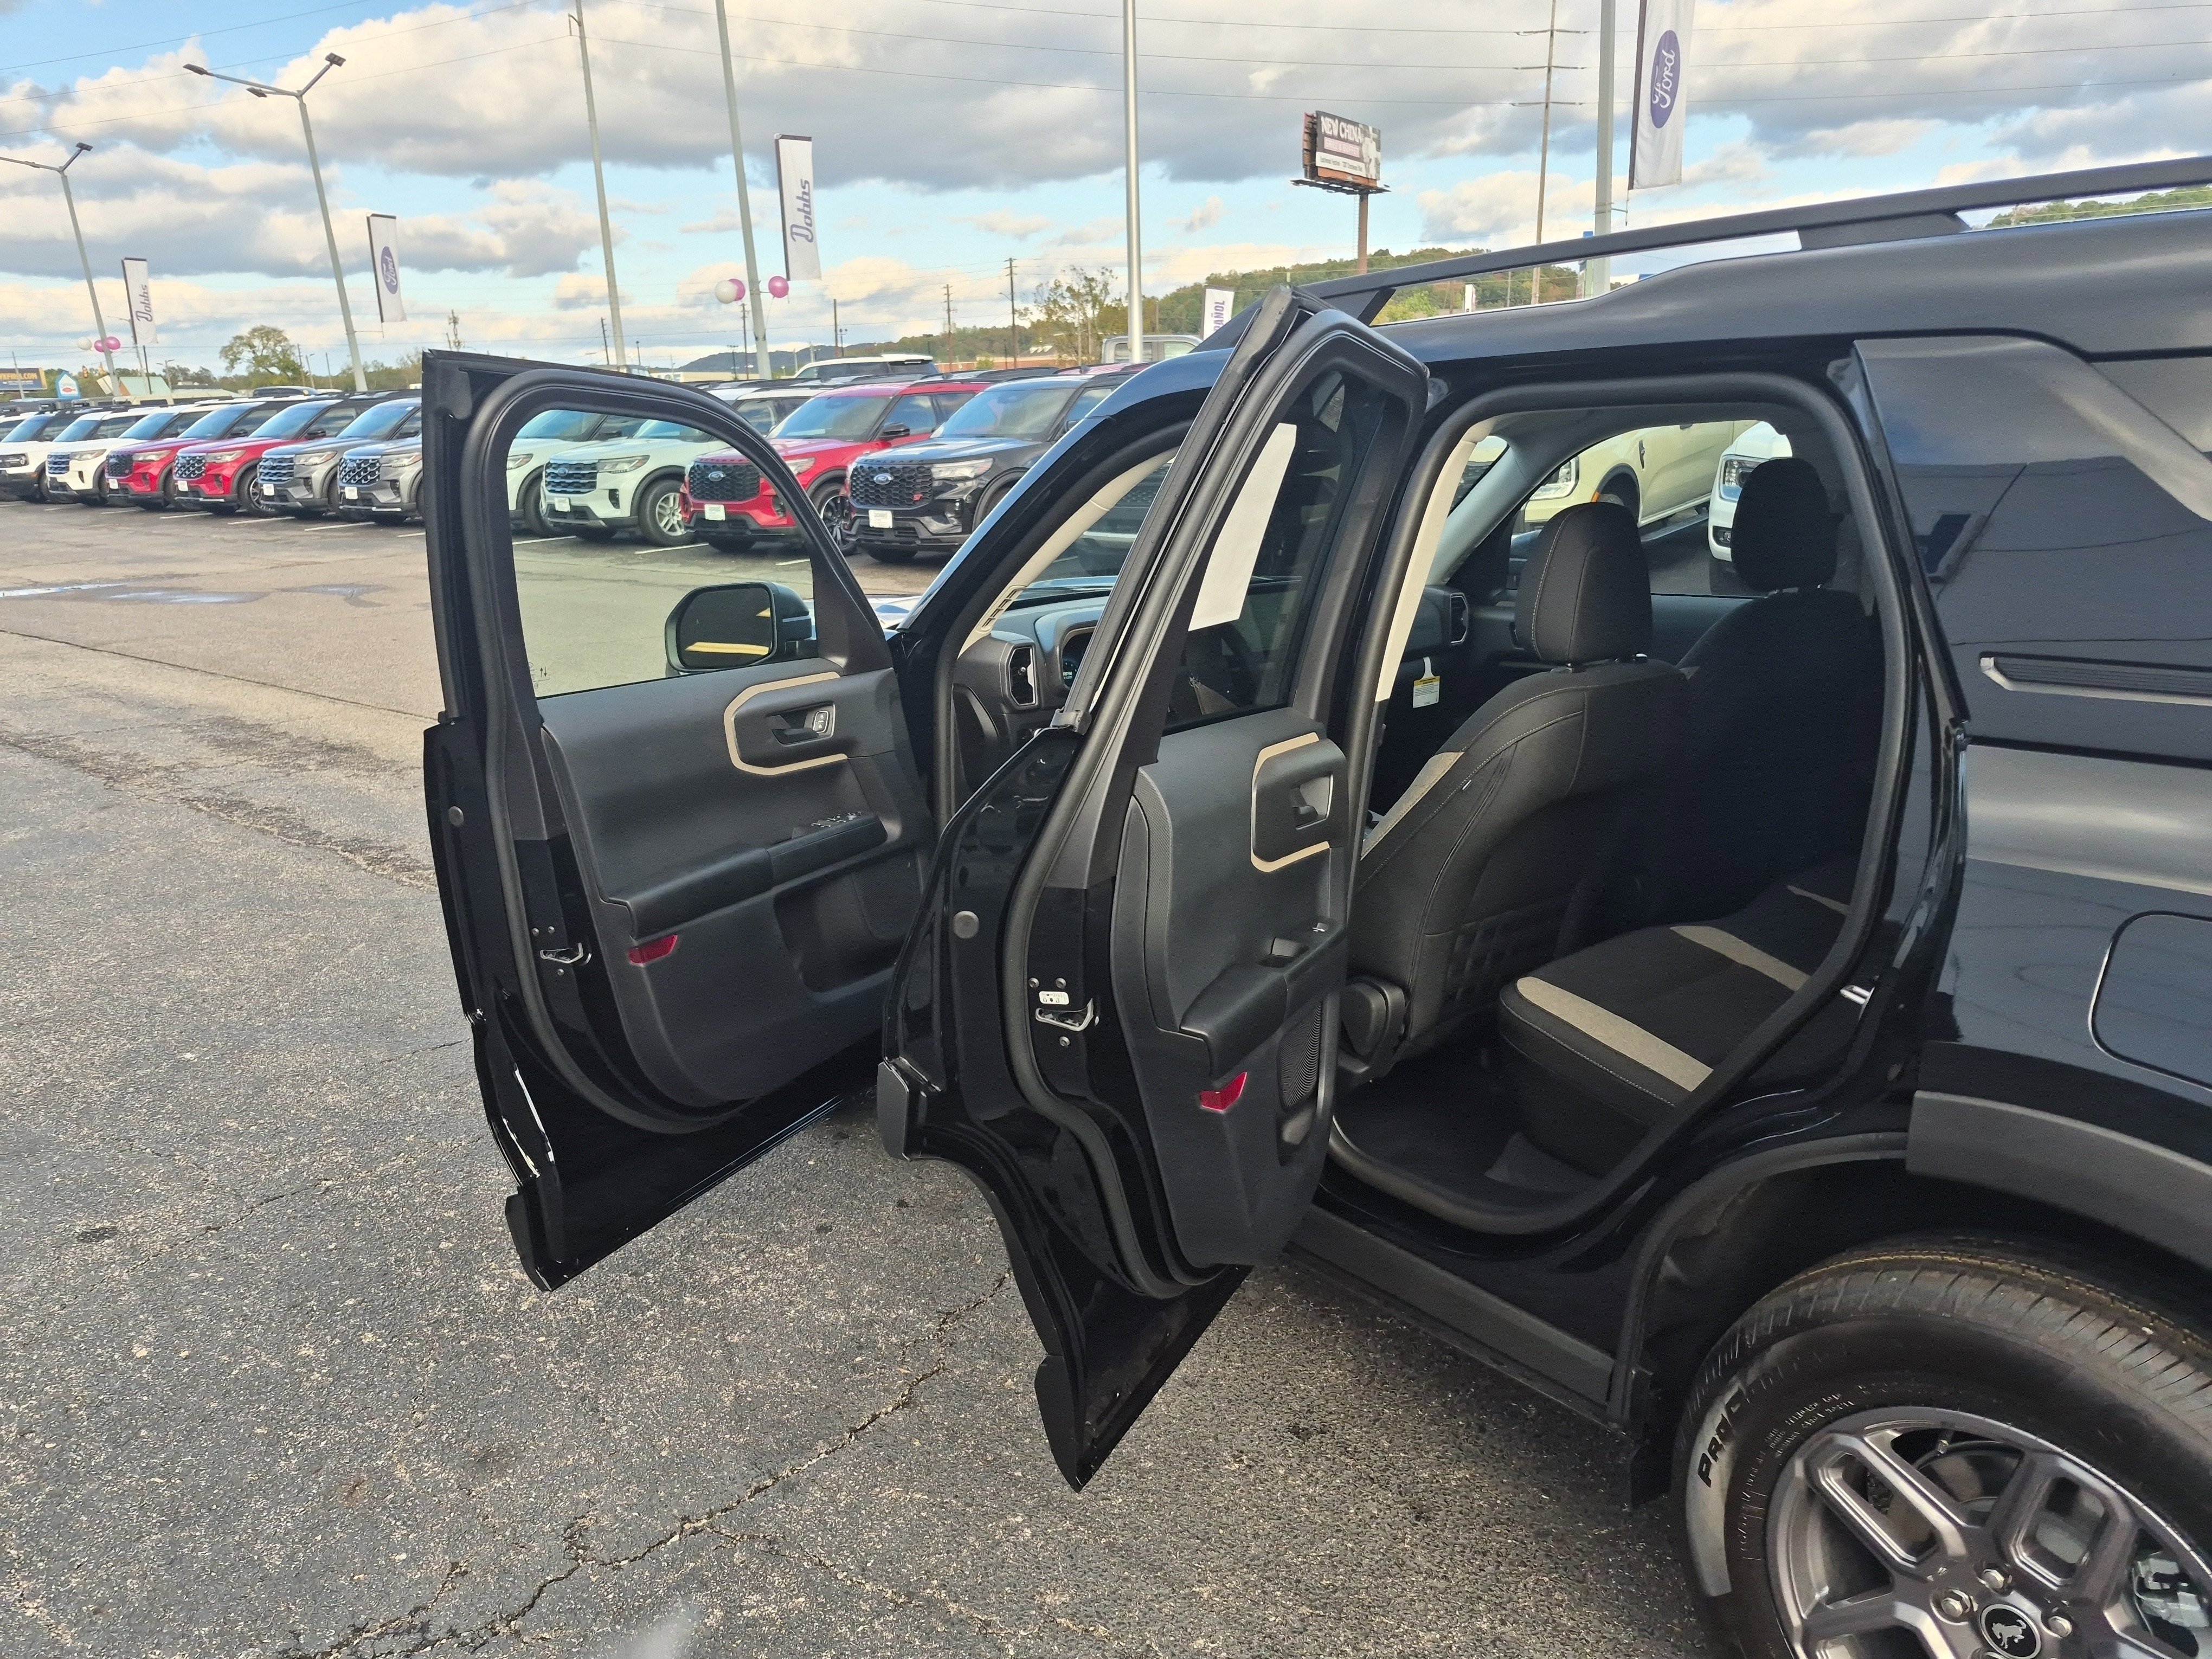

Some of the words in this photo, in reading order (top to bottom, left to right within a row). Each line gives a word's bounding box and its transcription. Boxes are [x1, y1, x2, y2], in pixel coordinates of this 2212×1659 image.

[1651, 49, 1675, 108] Ford
[1321, 115, 1339, 137] NEW
[790, 178, 814, 243] Dobbs
[382, 255, 397, 285] Ford
[136, 284, 153, 322] Dobbs
